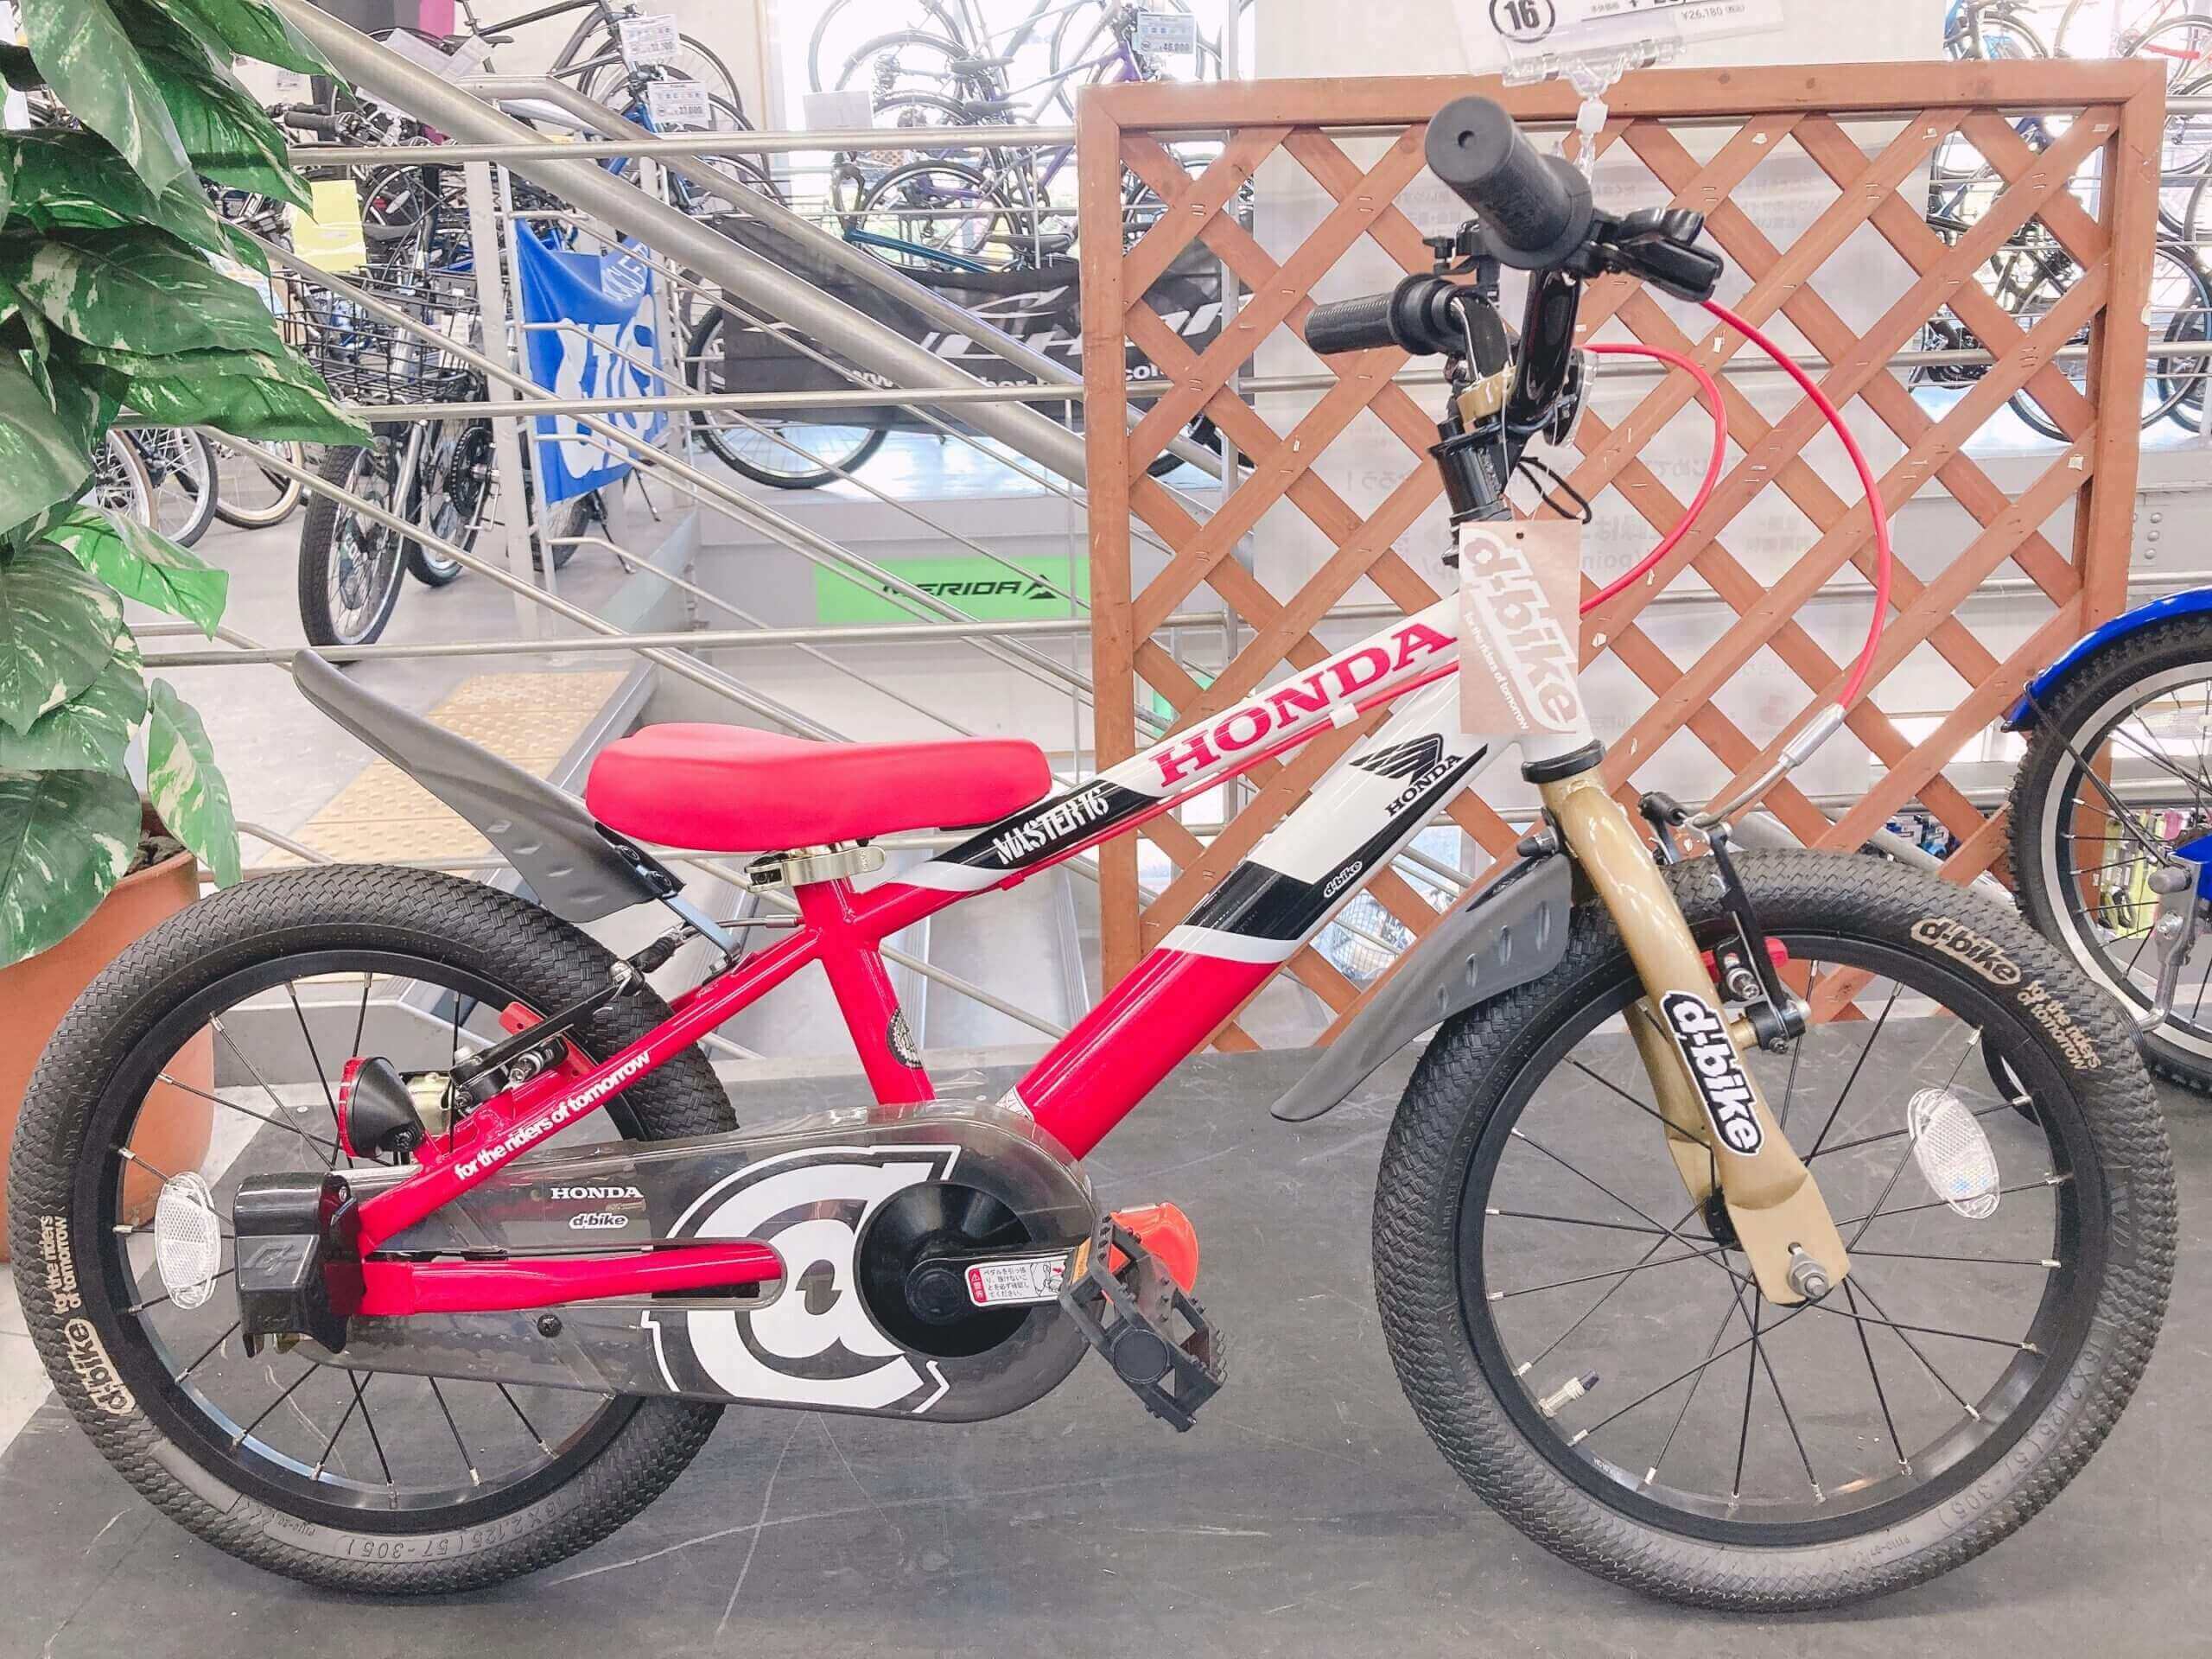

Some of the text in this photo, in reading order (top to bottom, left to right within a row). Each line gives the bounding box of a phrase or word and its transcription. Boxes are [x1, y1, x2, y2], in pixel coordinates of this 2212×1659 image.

[1503, 0, 1541, 31] 16
[1148, 623, 1459, 787] HONDA
[1480, 642, 1498, 674] riders
[1499, 681, 1530, 731] tomorrow
[1384, 754, 1465, 817] HONDA
[2018, 991, 2088, 1070] of tomorrow
[2027, 980, 2102, 1069] for the riders
[454, 1050, 651, 1180] for the riders of tomorrow
[550, 1186, 645, 1199] HONDA
[40, 1215, 70, 1314] for the riders
[54, 1216, 78, 1292] tomorrow
